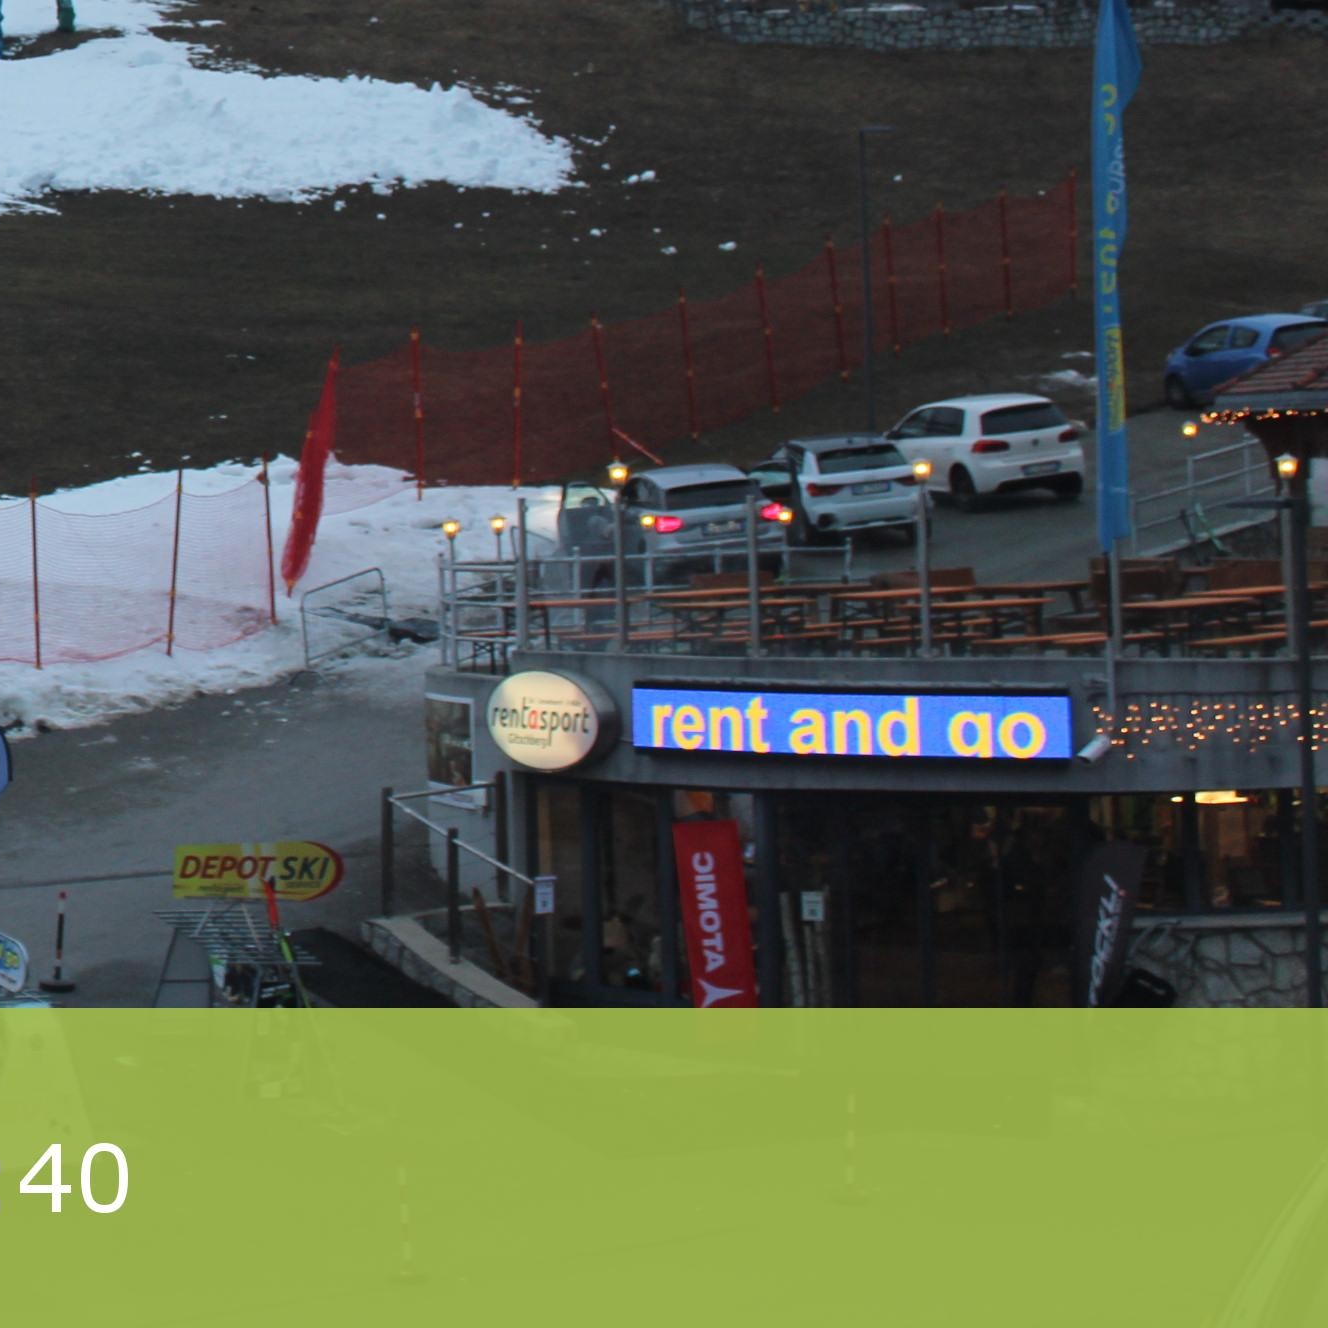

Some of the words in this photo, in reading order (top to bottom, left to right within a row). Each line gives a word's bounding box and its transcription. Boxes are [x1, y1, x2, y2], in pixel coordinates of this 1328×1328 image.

[491, 696, 590, 748] rentasport
[651, 696, 771, 754] rent
[788, 696, 922, 757] and
[947, 709, 1048, 760] go
[178, 854, 277, 881] DEPOT
[278, 855, 331, 882] SKI
